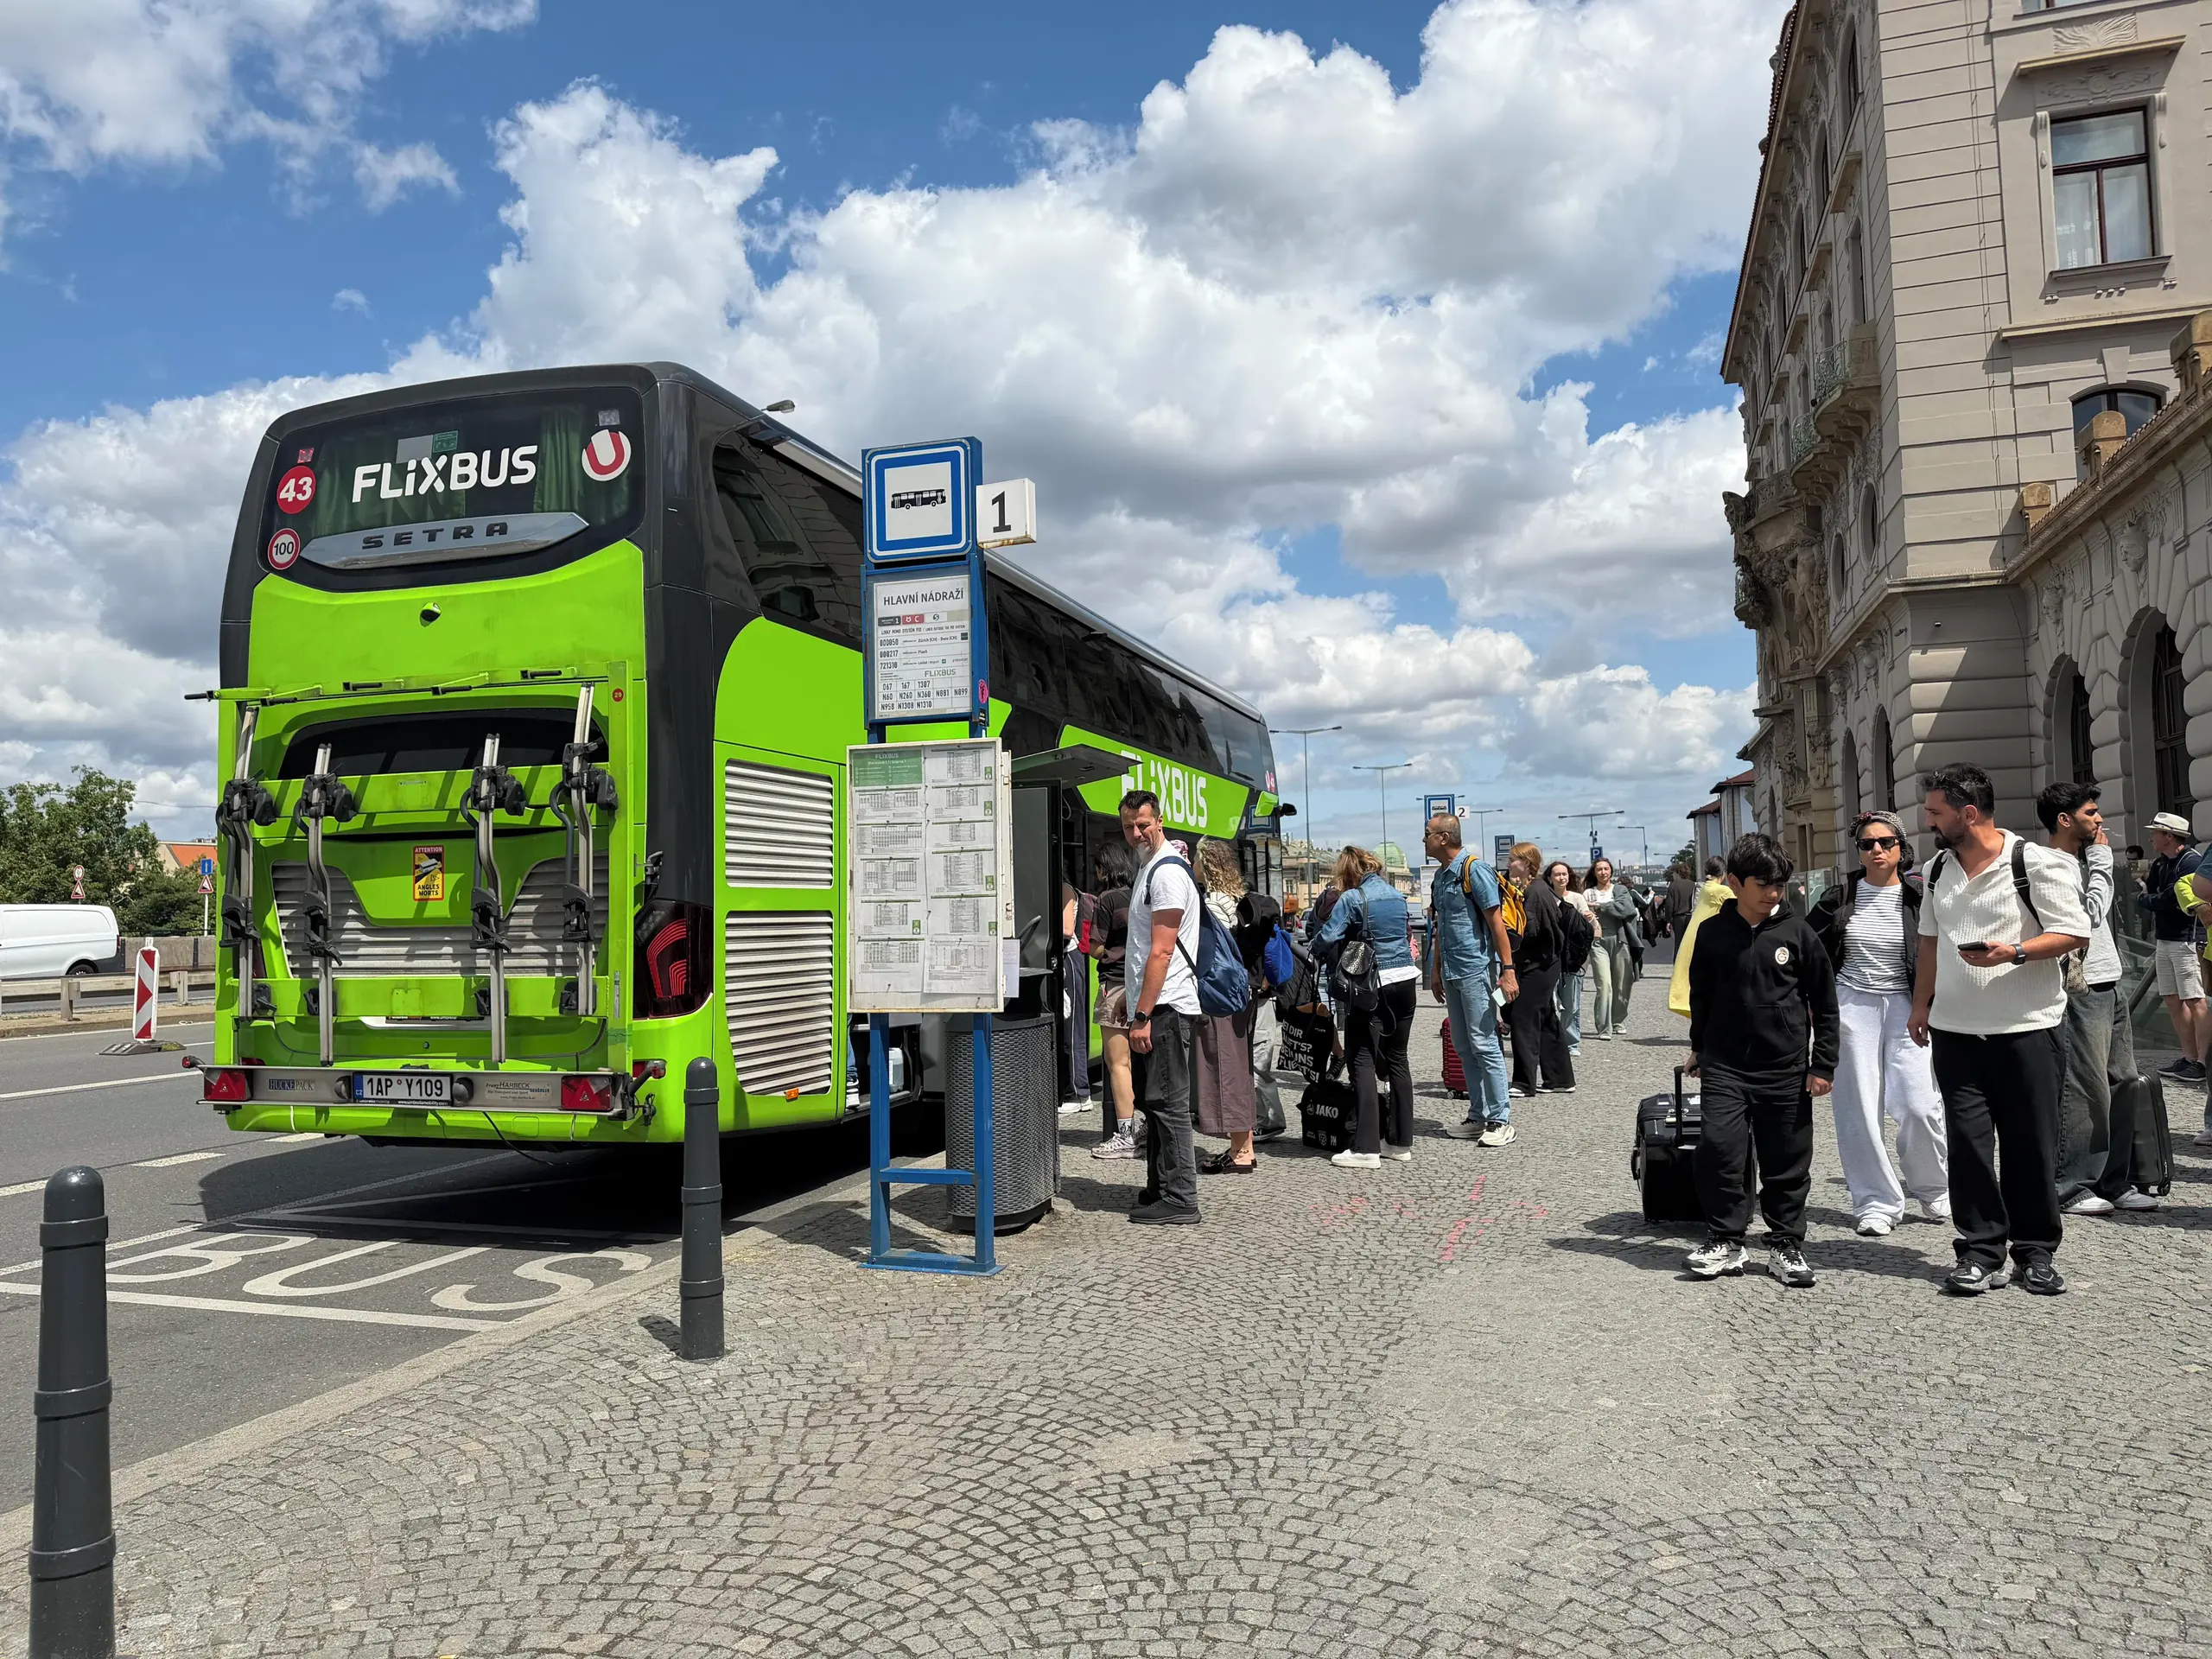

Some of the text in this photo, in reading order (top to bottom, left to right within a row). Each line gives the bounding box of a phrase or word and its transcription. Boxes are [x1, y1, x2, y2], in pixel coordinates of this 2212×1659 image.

[352, 445, 538, 503] FLiXBUS
[279, 476, 313, 502] 43
[991, 490, 1011, 533] 1
[361, 522, 509, 550] SETRA
[274, 541, 294, 556] 100
[883, 588, 964, 606] HLAVNÍ NÁDRAŽÍ
[925, 668, 956, 677] FLiXBUS
[1458, 807, 1465, 818] 2
[1593, 849, 1600, 859] P
[1289, 1025, 1303, 1038] DIR
[367, 1078, 443, 1097] 1AP Y109
[1315, 1104, 1339, 1119] JAKO
[105, 1233, 652, 1312] BUS
